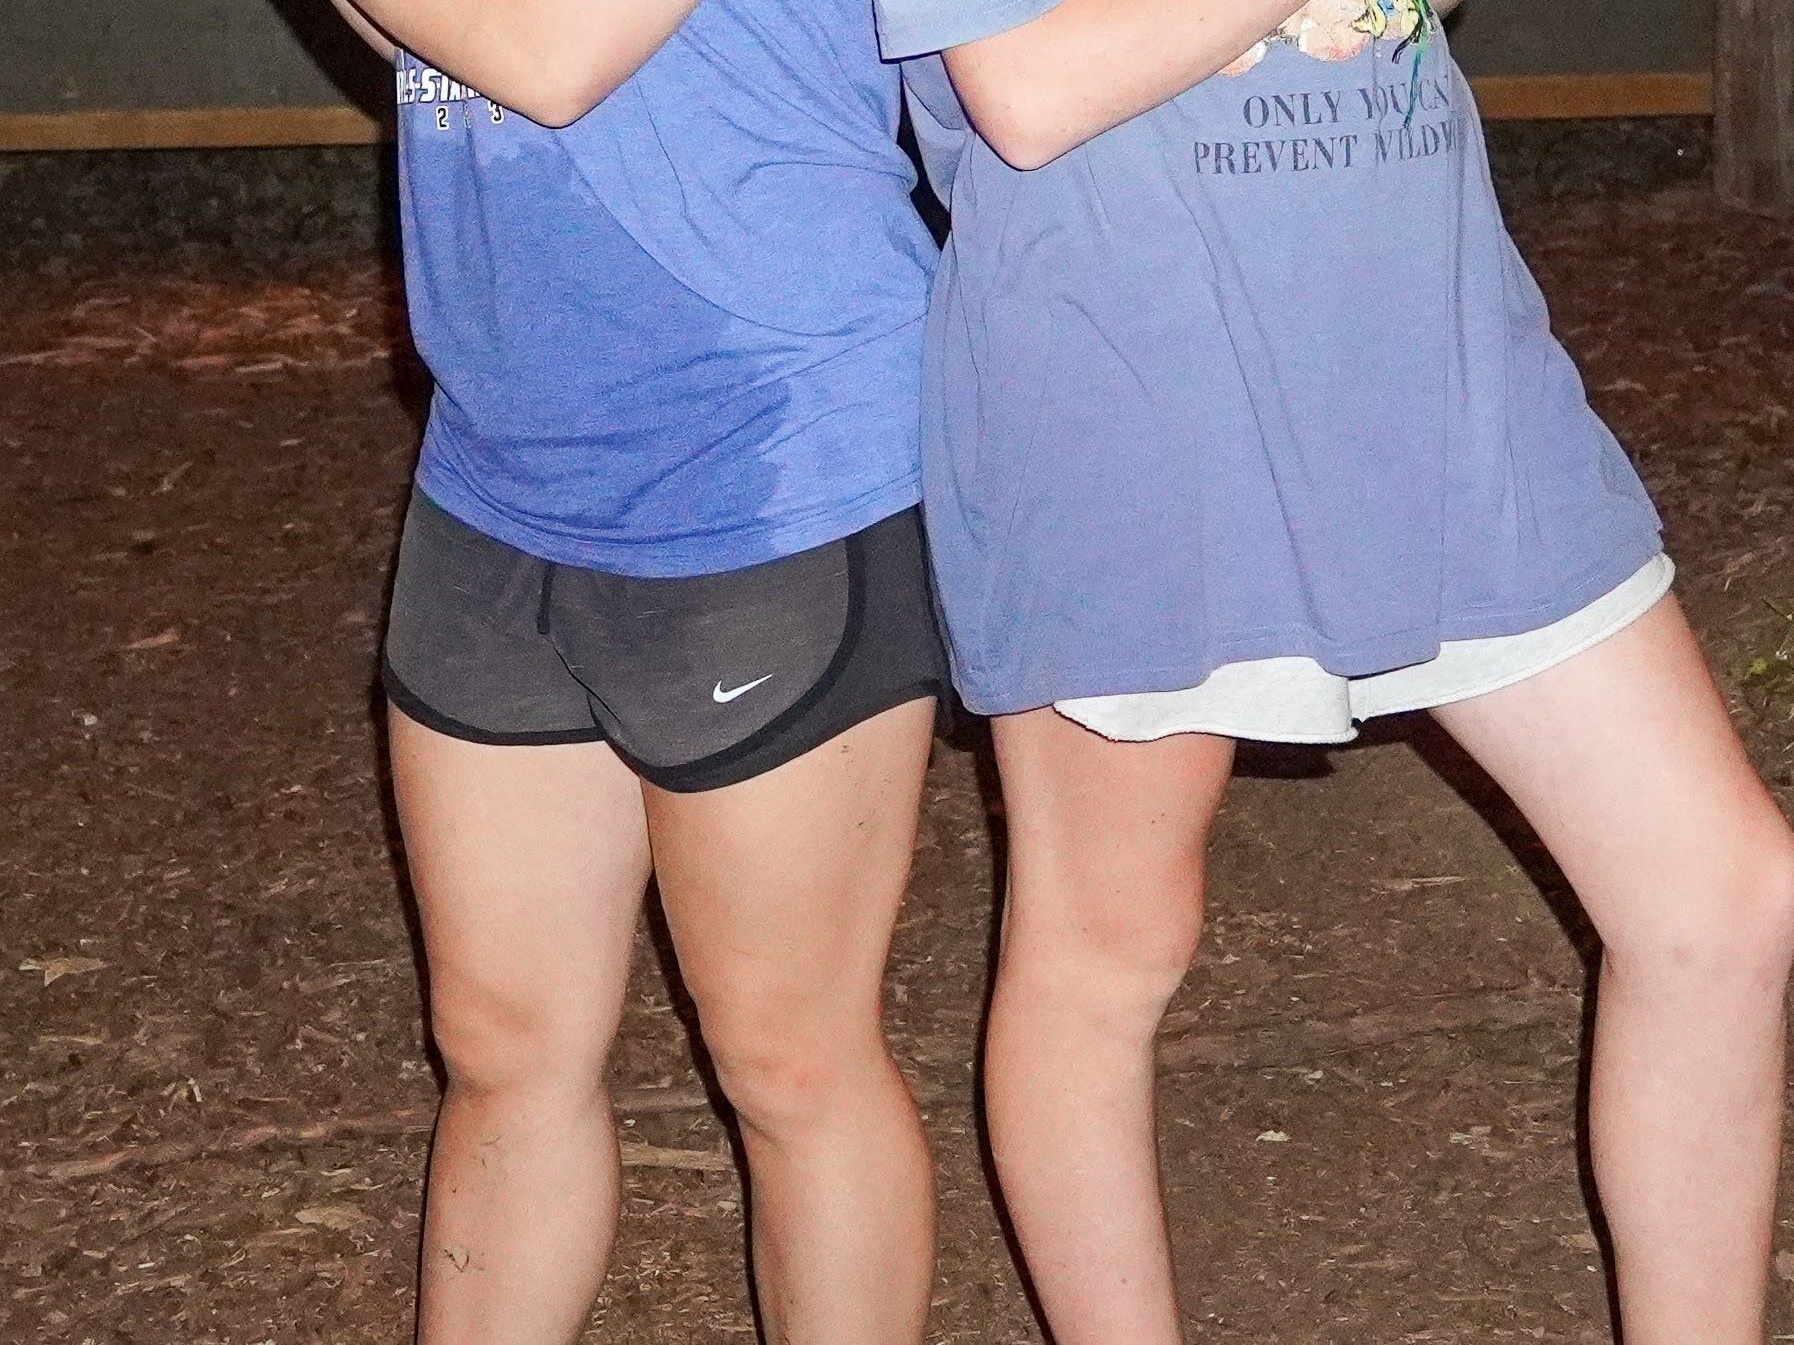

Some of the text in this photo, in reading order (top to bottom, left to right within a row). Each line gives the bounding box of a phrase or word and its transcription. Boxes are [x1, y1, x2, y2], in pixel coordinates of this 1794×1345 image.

[1243, 90, 1341, 128] ONLY
[1357, 81, 1410, 120] YOU
[1194, 134, 1358, 175] PREVENT
